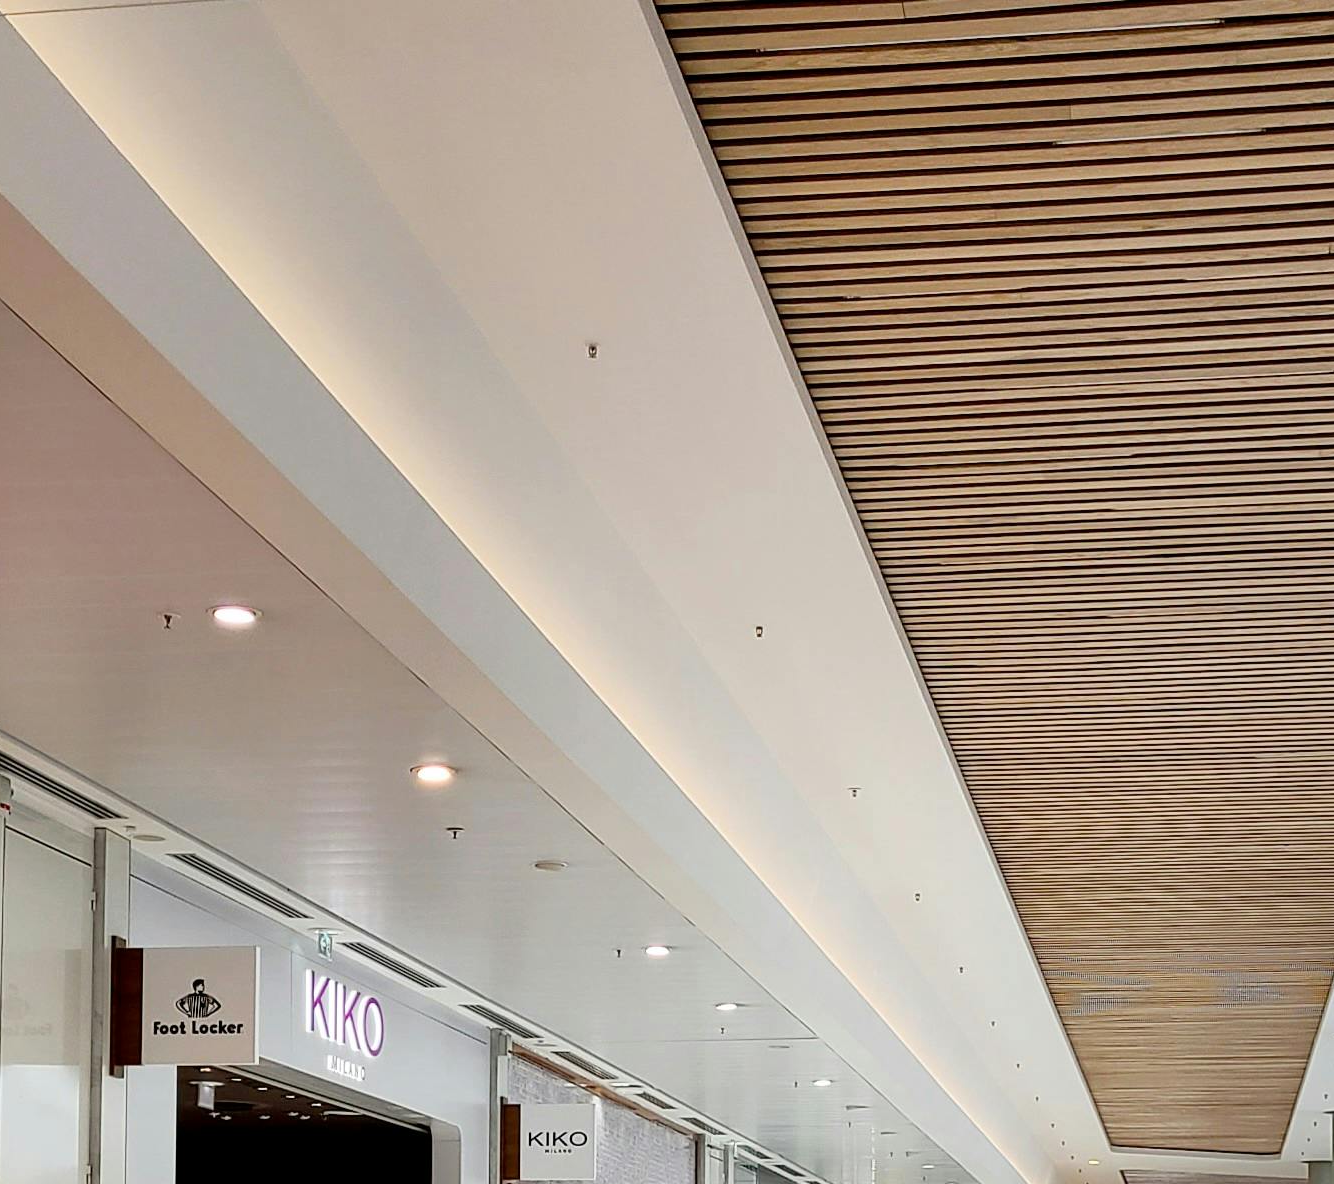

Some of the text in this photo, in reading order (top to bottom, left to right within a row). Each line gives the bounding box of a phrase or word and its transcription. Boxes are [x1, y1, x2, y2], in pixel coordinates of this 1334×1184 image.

[306, 968, 385, 1058] KIKO
[153, 1020, 244, 1036] Foot Locker
[327, 1054, 366, 1082] MILANO
[528, 1131, 588, 1147] KIKO
